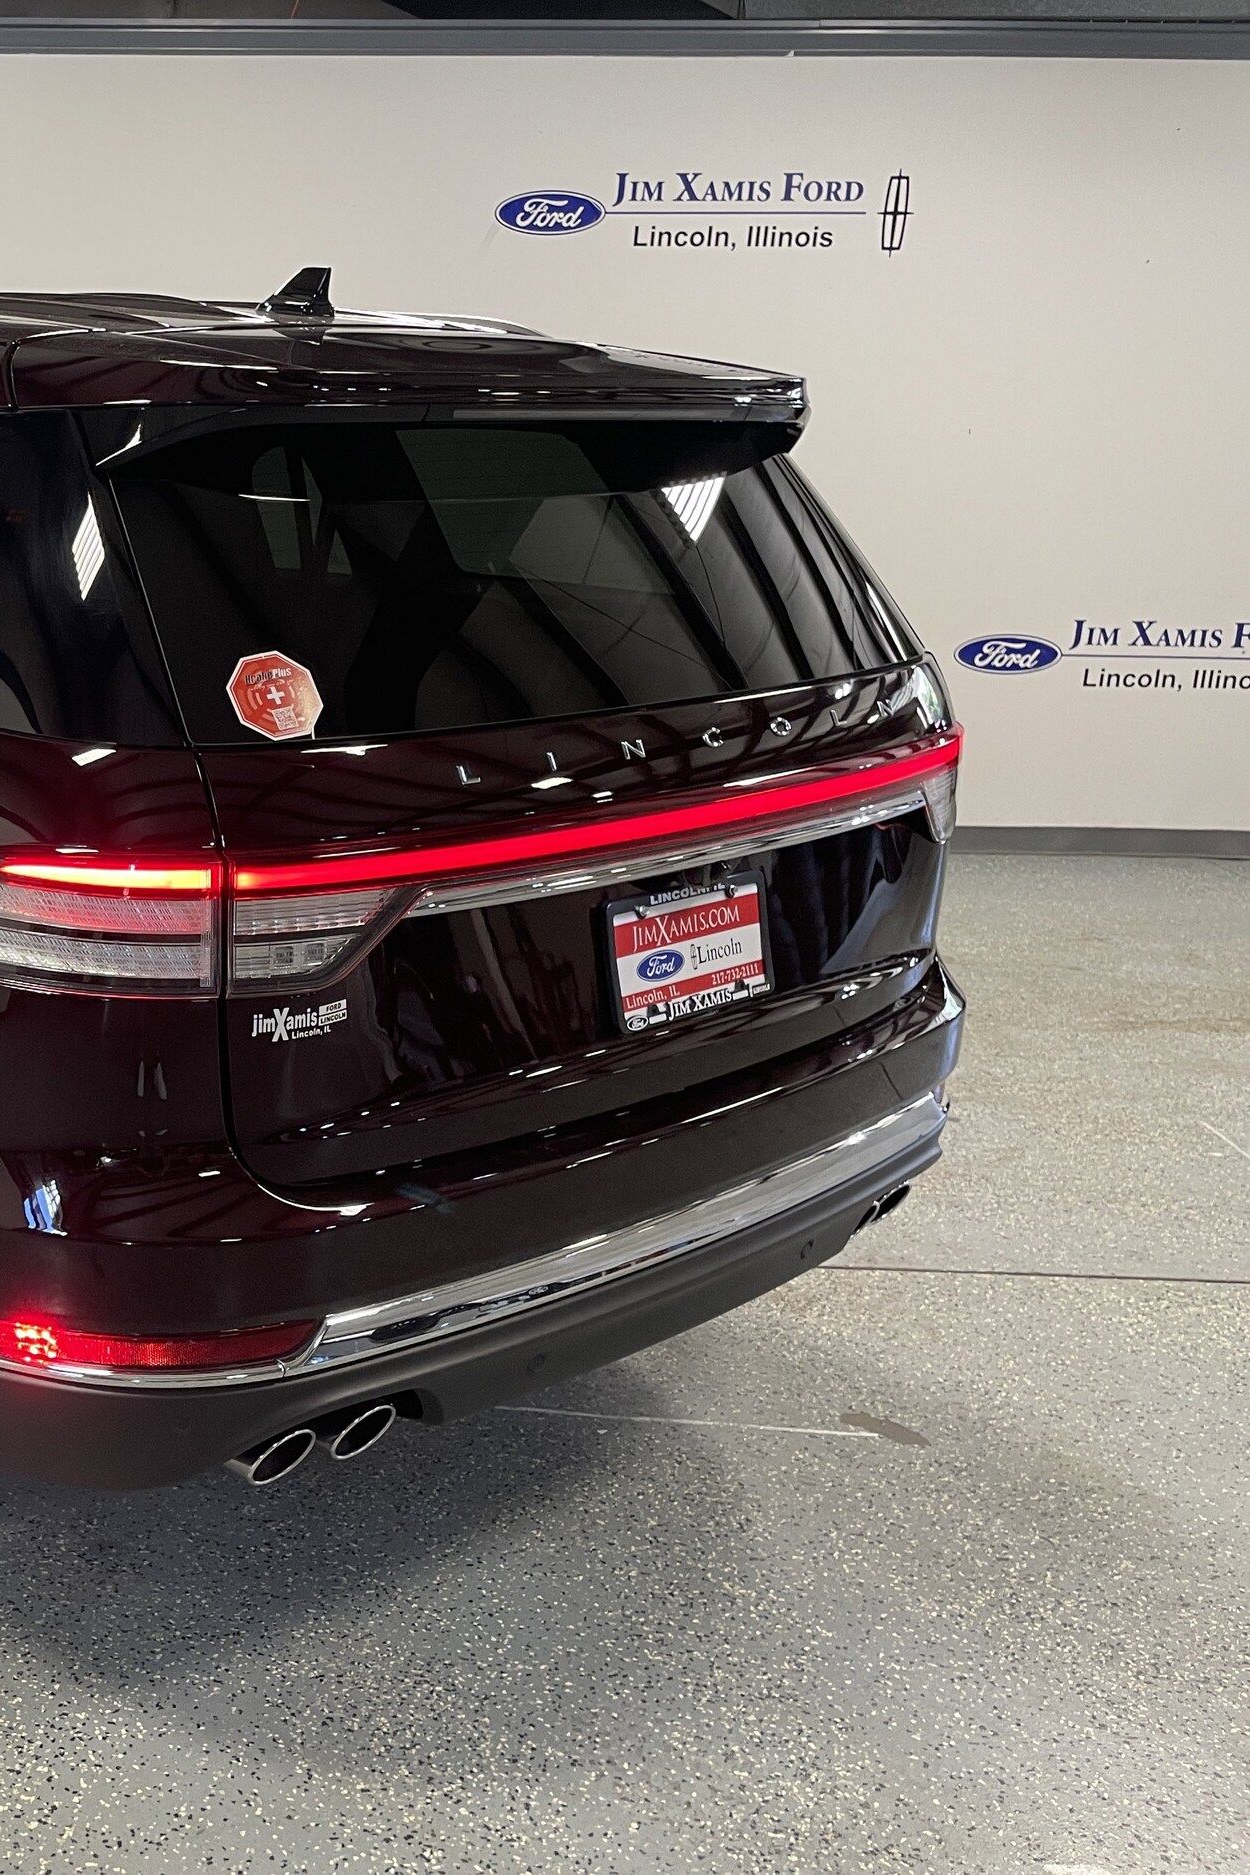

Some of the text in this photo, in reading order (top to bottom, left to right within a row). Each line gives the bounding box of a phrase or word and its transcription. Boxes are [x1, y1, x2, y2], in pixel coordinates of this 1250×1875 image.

[612, 172, 865, 207] JIM XAMIS FORD
[515, 196, 582, 228] Ford
[633, 226, 834, 250] Lincoln, Illinois
[1069, 619, 1120, 650] JIM
[1128, 620, 1223, 648] XAMIS
[973, 640, 1040, 668] Ford
[1082, 668, 1250, 692] Lincoln, Illino
[455, 700, 895, 786] LINCOLN
[633, 905, 740, 952] JIMXAMIS.COM
[647, 954, 675, 977] Ford
[697, 938, 742, 964] Lincoln
[625, 985, 680, 1009] Lincoln, IL
[668, 989, 733, 1021] JIM XAMIS
[251, 1007, 318, 1042] jimXamis
[291, 1025, 332, 1040] Lincoln, IL
